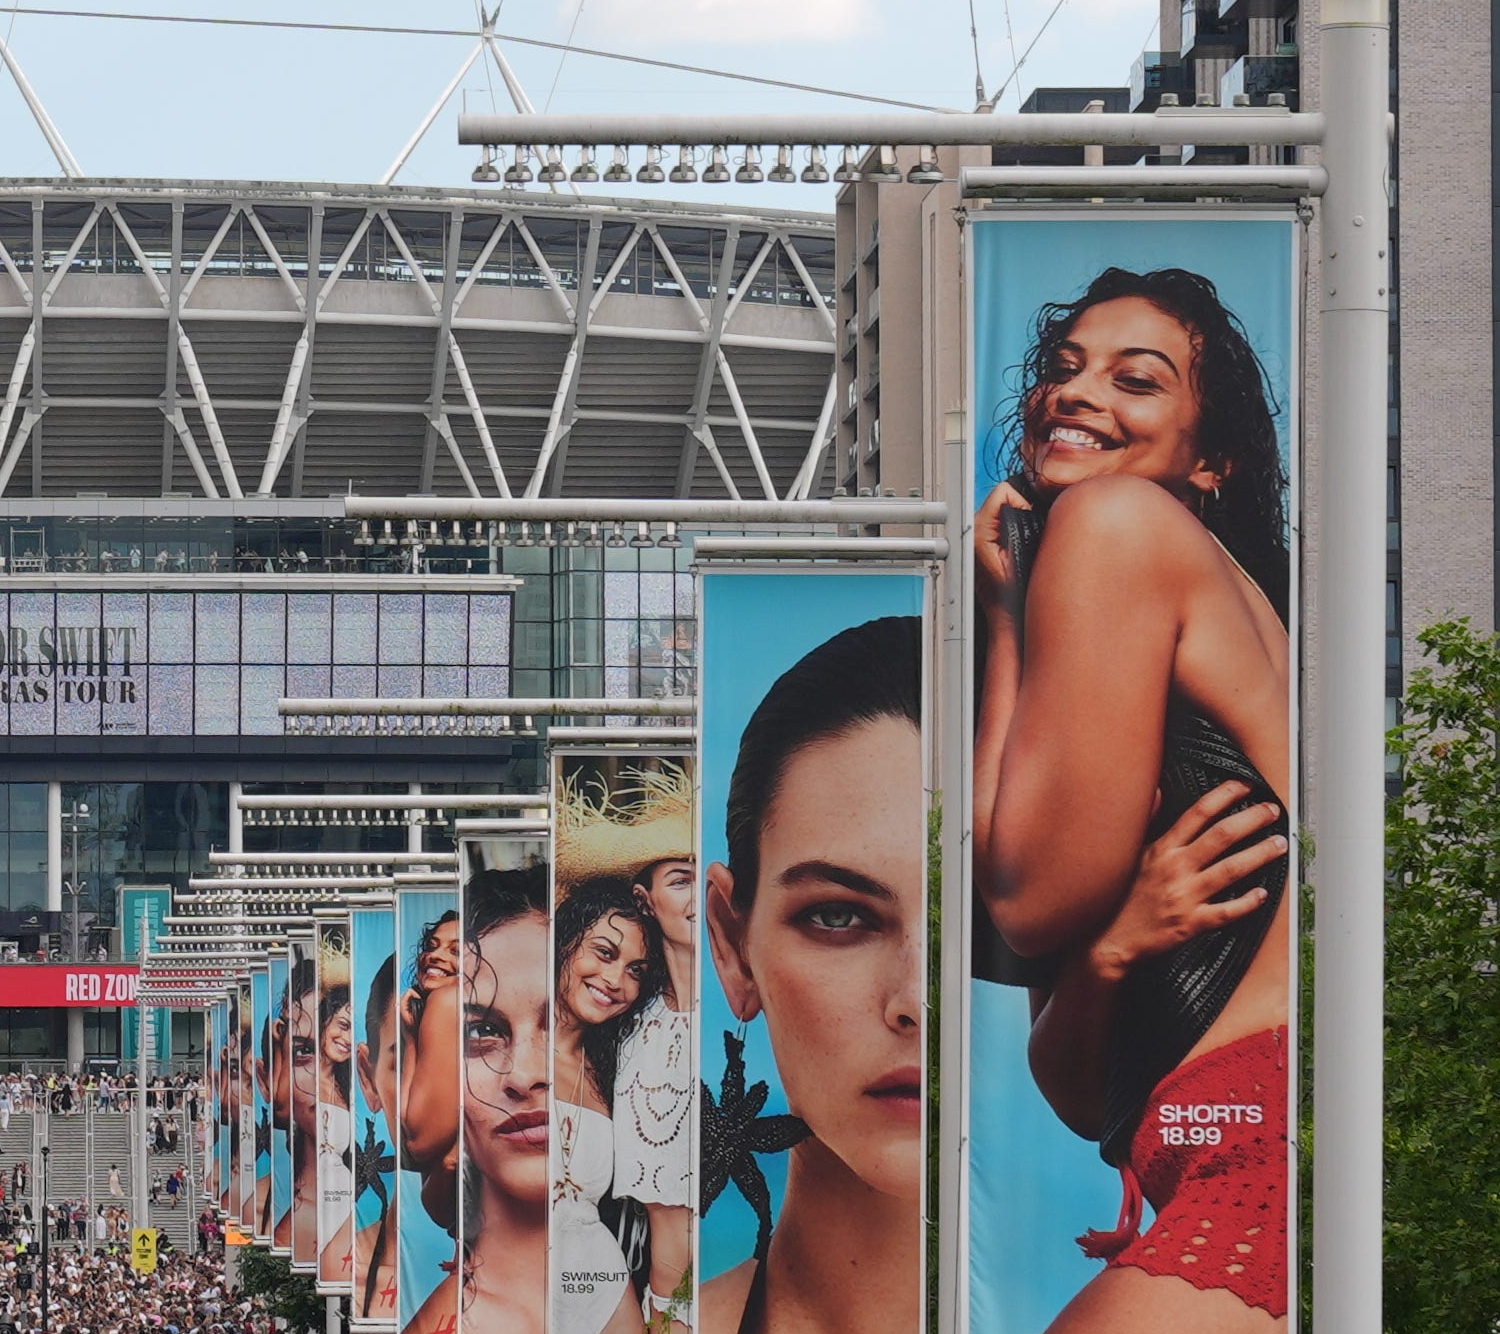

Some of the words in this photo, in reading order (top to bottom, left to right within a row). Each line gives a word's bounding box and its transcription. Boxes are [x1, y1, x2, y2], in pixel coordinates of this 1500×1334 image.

[38, 626, 137, 677] SWIFT
[59, 680, 137, 703] TOUR
[66, 974, 101, 1001] RED
[105, 973, 139, 1002] ZON
[1158, 1104, 1264, 1125] SHORTS
[1158, 1126, 1222, 1146] 18.99
[561, 1270, 628, 1282] SWIMSUIT
[561, 1282, 595, 1294] 18.99
